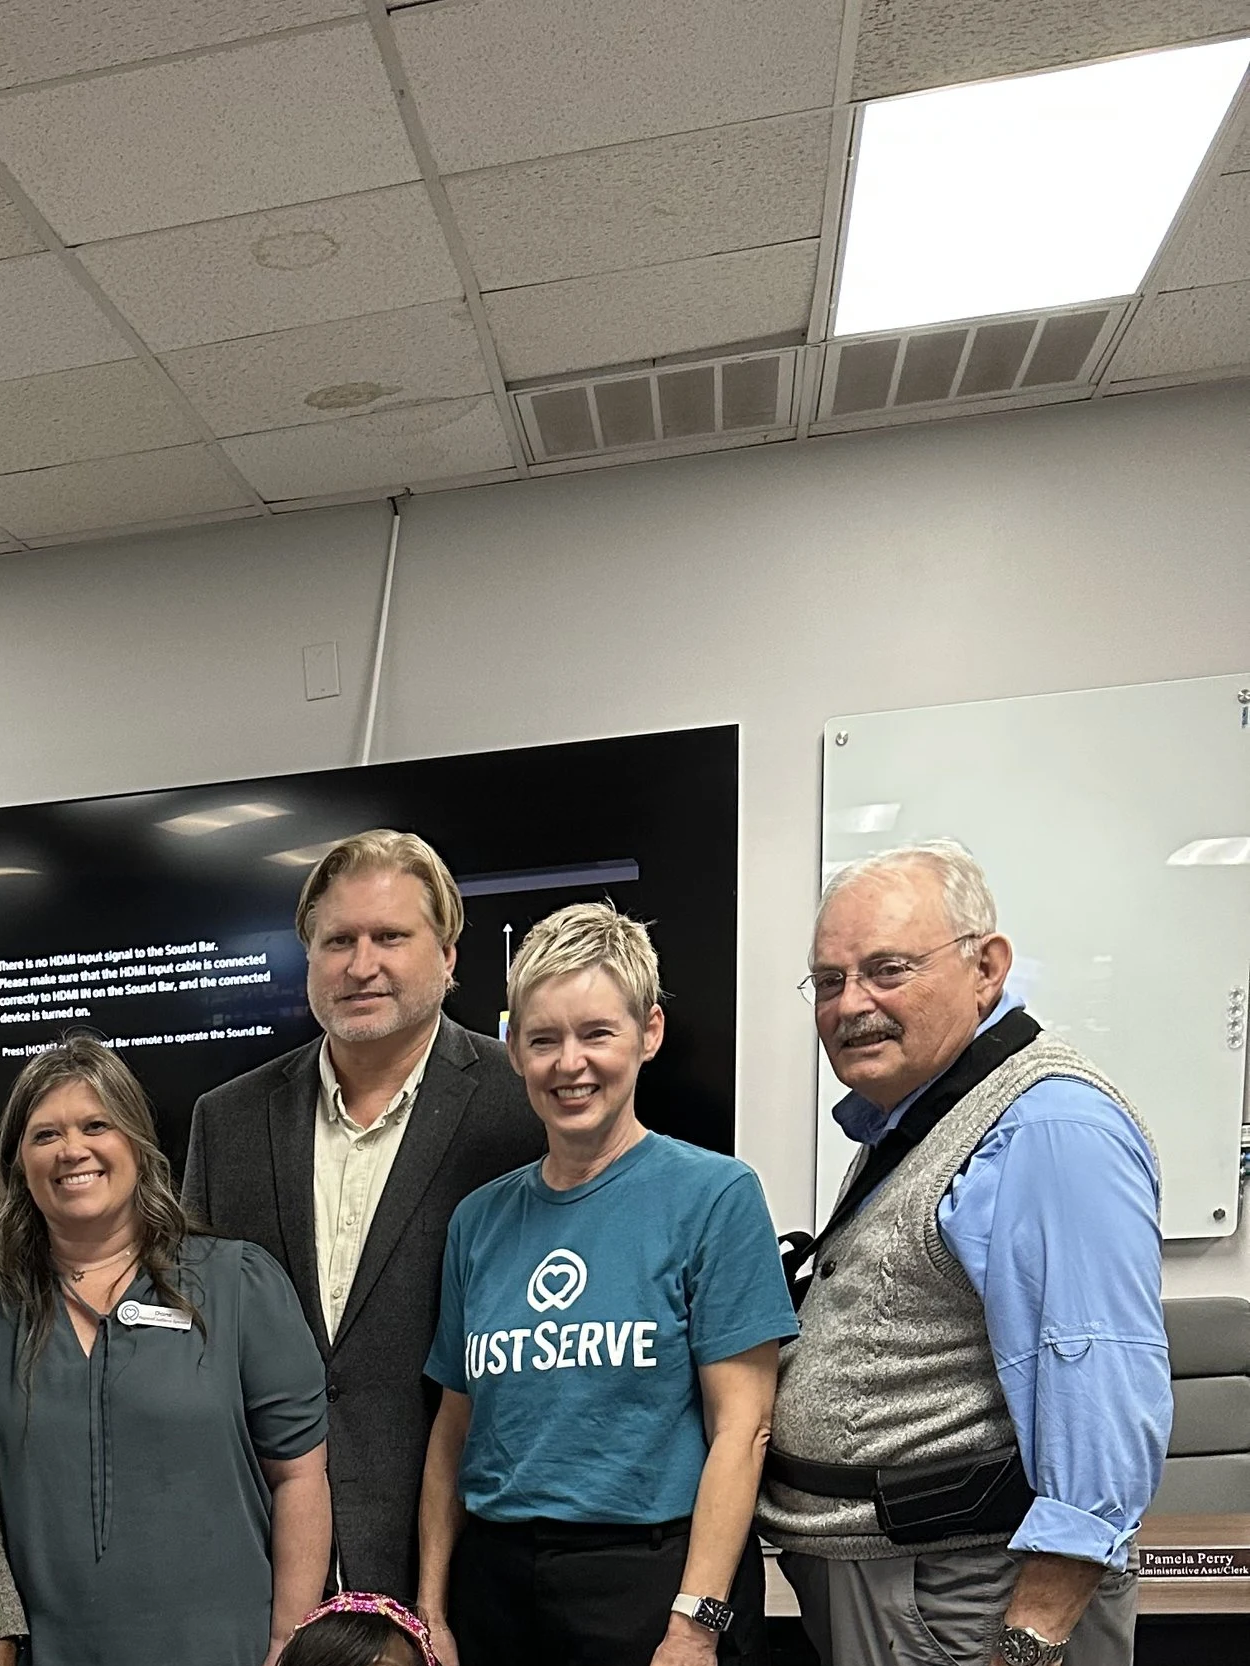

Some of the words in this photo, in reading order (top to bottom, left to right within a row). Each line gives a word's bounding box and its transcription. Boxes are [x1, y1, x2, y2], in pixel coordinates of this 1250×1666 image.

[25, 959, 33, 969] is
[35, 959, 48, 968] no
[50, 954, 76, 967] HDMI
[77, 952, 103, 965] input
[104, 948, 133, 963] signal
[135, 948, 145, 959] to
[147, 946, 164, 957] the
[165, 942, 197, 955] Sound
[198, 941, 219, 952] Bar.
[30, 974, 56, 986] make
[58, 973, 79, 983] sure
[80, 970, 100, 981] that
[101, 968, 118, 979] the
[120, 965, 147, 977] HDMI
[148, 962, 174, 976] input
[175, 960, 202, 972] cable
[203, 959, 212, 970] is
[213, 953, 266, 968] connected
[0, 992, 39, 1006] correctly
[41, 992, 51, 1002] to
[52, 990, 79, 1001] HDMI
[80, 988, 91, 999] IN
[92, 988, 105, 998] on
[107, 985, 124, 996] the
[125, 982, 156, 994] Sound
[158, 981, 177, 992] Bar,
[179, 978, 198, 990] and
[200, 977, 217, 988] the
[218, 970, 271, 986] connected
[0, 1011, 30, 1023] device
[32, 1010, 40, 1020] is
[41, 1007, 73, 1019] turned
[75, 1007, 91, 1017] on.
[2, 1047, 24, 1057] Press
[116, 1038, 130, 1048] Bar
[131, 1035, 162, 1046] remote
[164, 1034, 174, 1043] to
[175, 1031, 209, 1044] operate
[210, 1030, 225, 1040] the
[226, 1026, 255, 1038] Sound
[256, 1026, 274, 1036] Bar.
[1138, 1566, 1199, 1575] dministrative
[1145, 1553, 1194, 1564] Pamela
[1197, 1552, 1234, 1566] Perry
